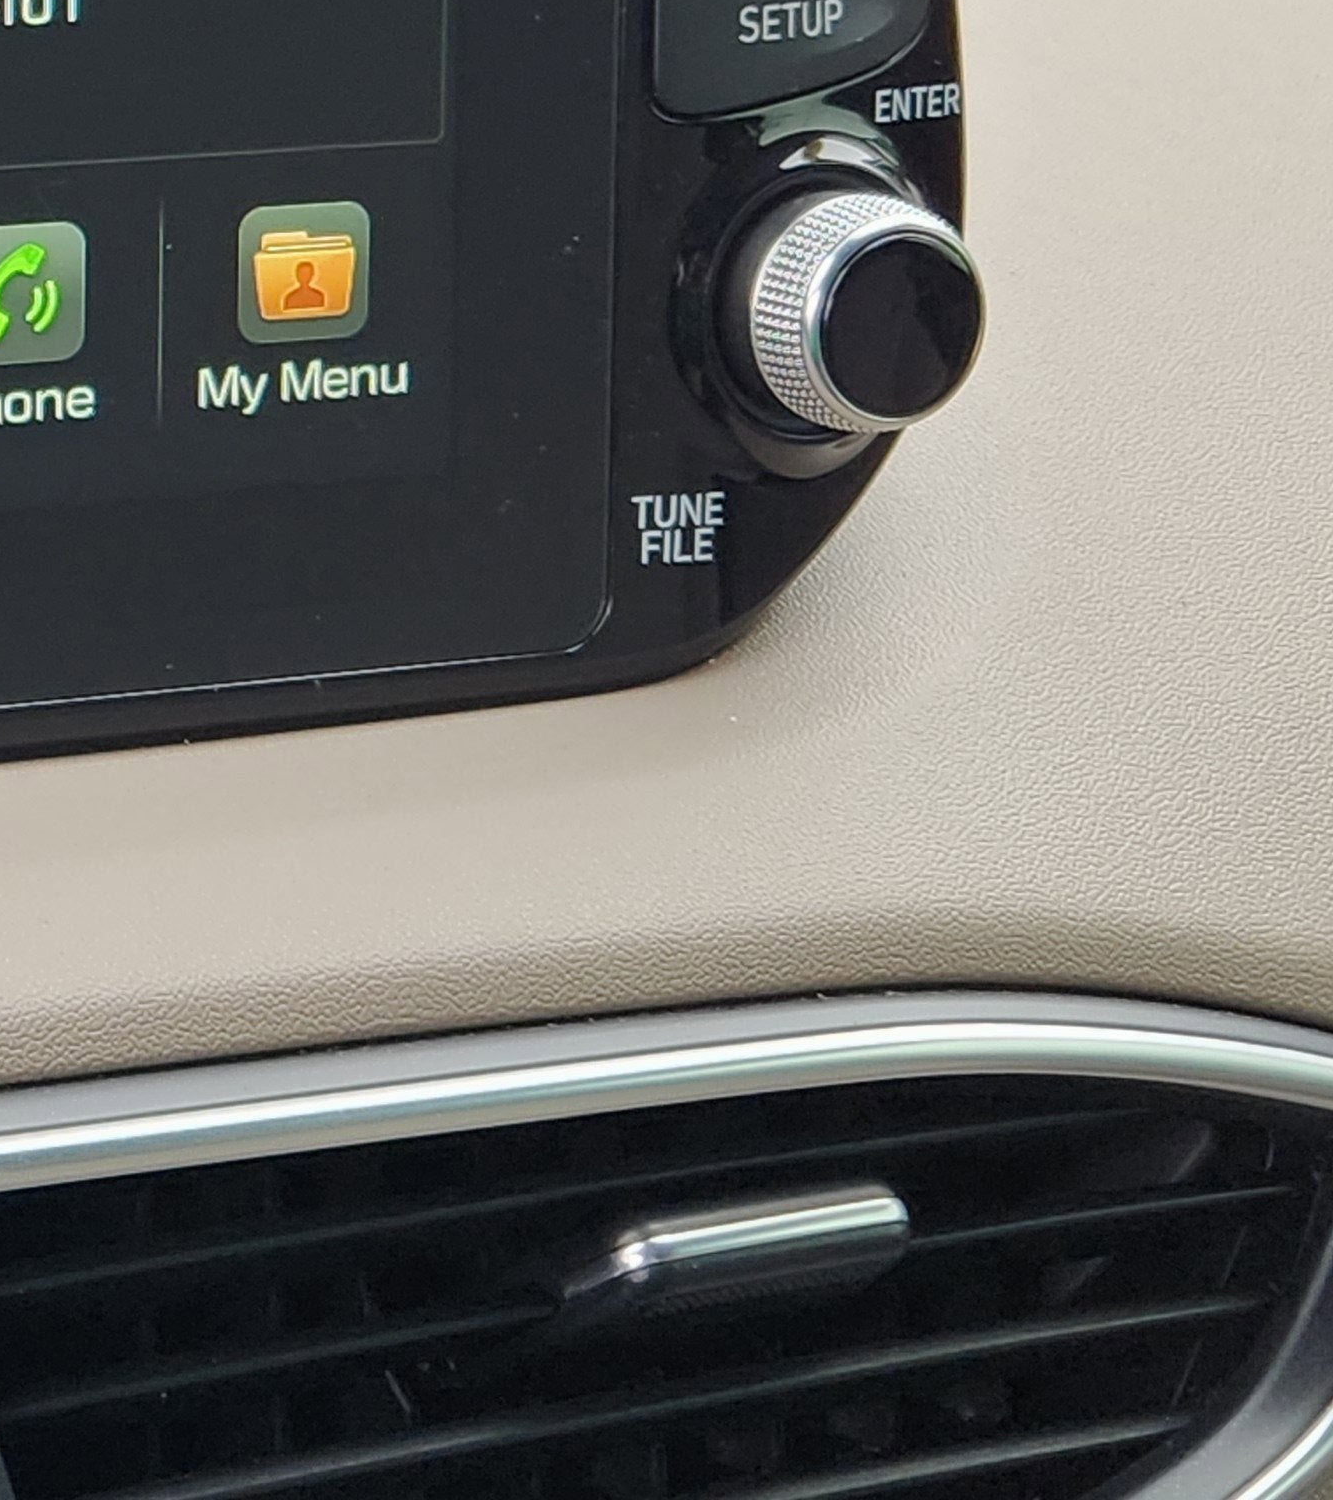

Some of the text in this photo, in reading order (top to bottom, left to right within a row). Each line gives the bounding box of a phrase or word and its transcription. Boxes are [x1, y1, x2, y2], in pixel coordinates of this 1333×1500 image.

[873, 81, 961, 124] ENTER
[197, 358, 409, 416] My Menu
[630, 491, 726, 530] TUNE
[639, 528, 716, 566] FILE
